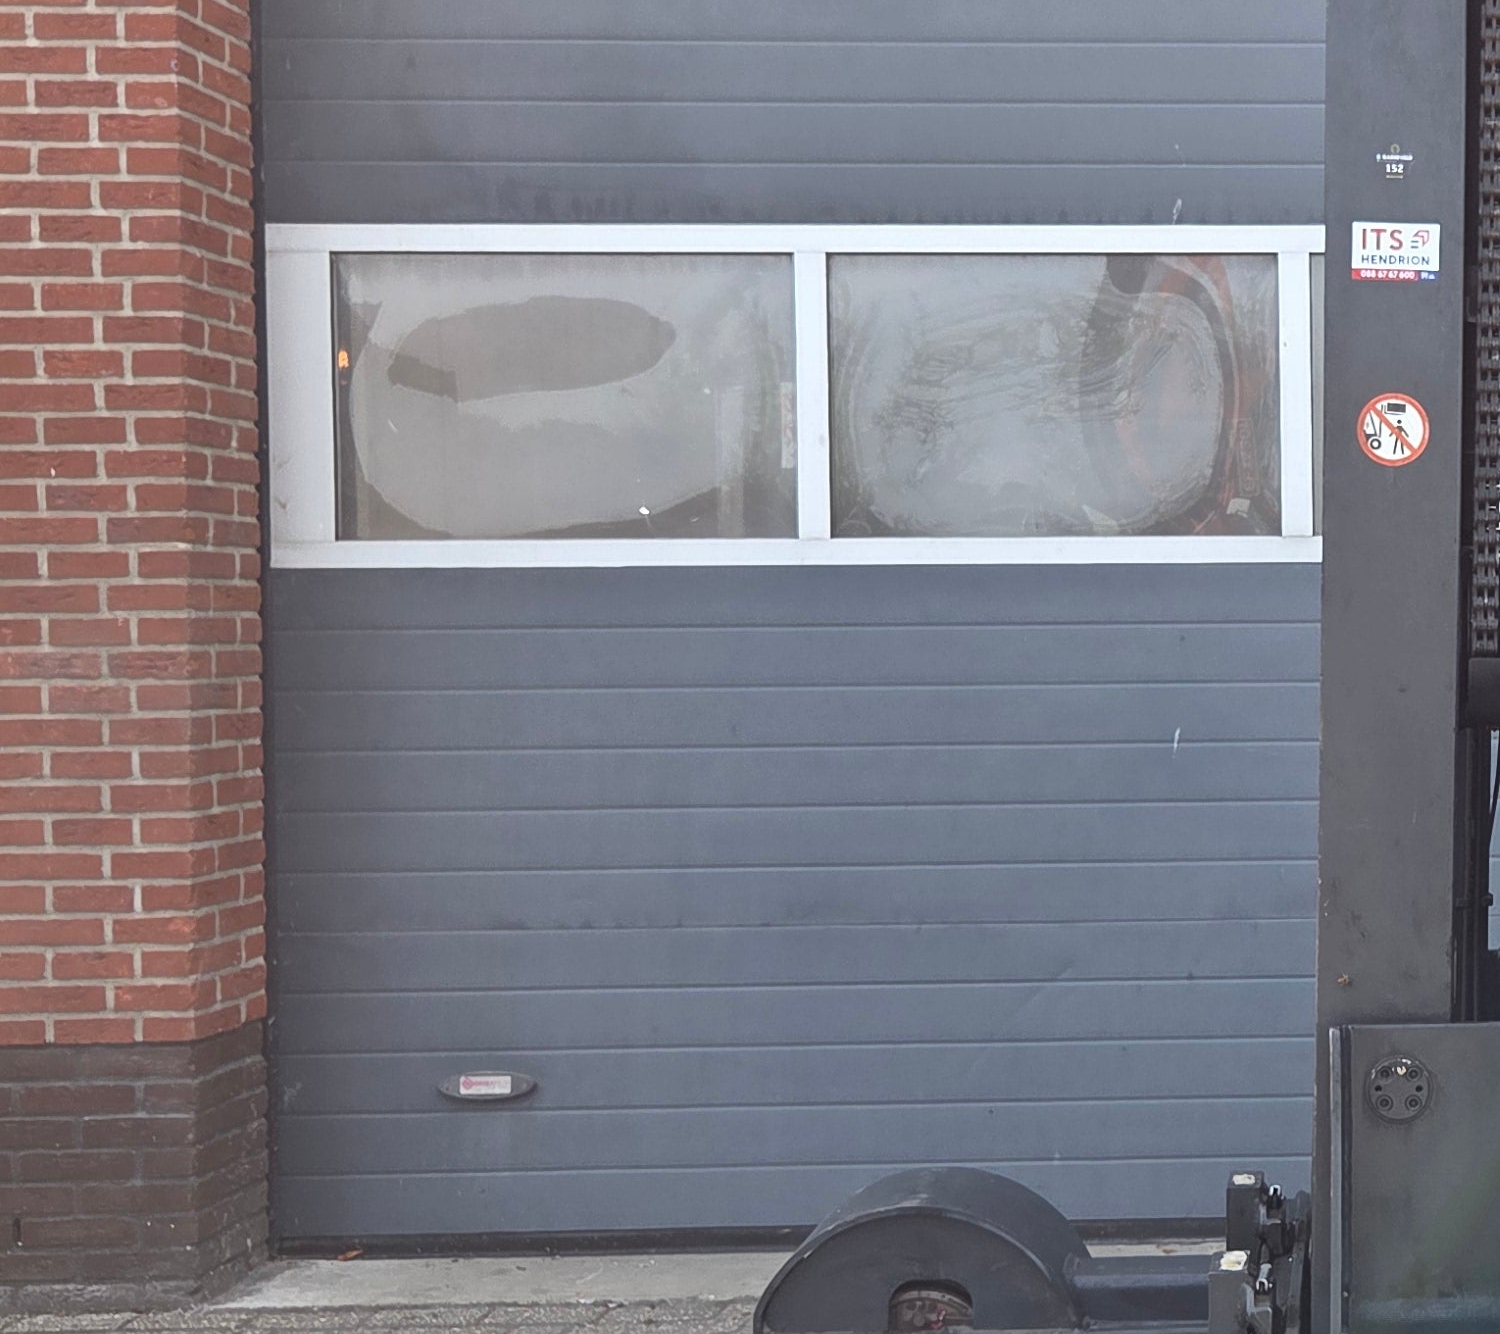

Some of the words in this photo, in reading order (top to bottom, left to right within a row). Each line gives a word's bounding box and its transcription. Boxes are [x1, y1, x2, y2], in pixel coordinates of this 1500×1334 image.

[1385, 163, 1404, 174] 152
[1361, 228, 1404, 251] ITS
[1361, 254, 1431, 266] HENDRION
